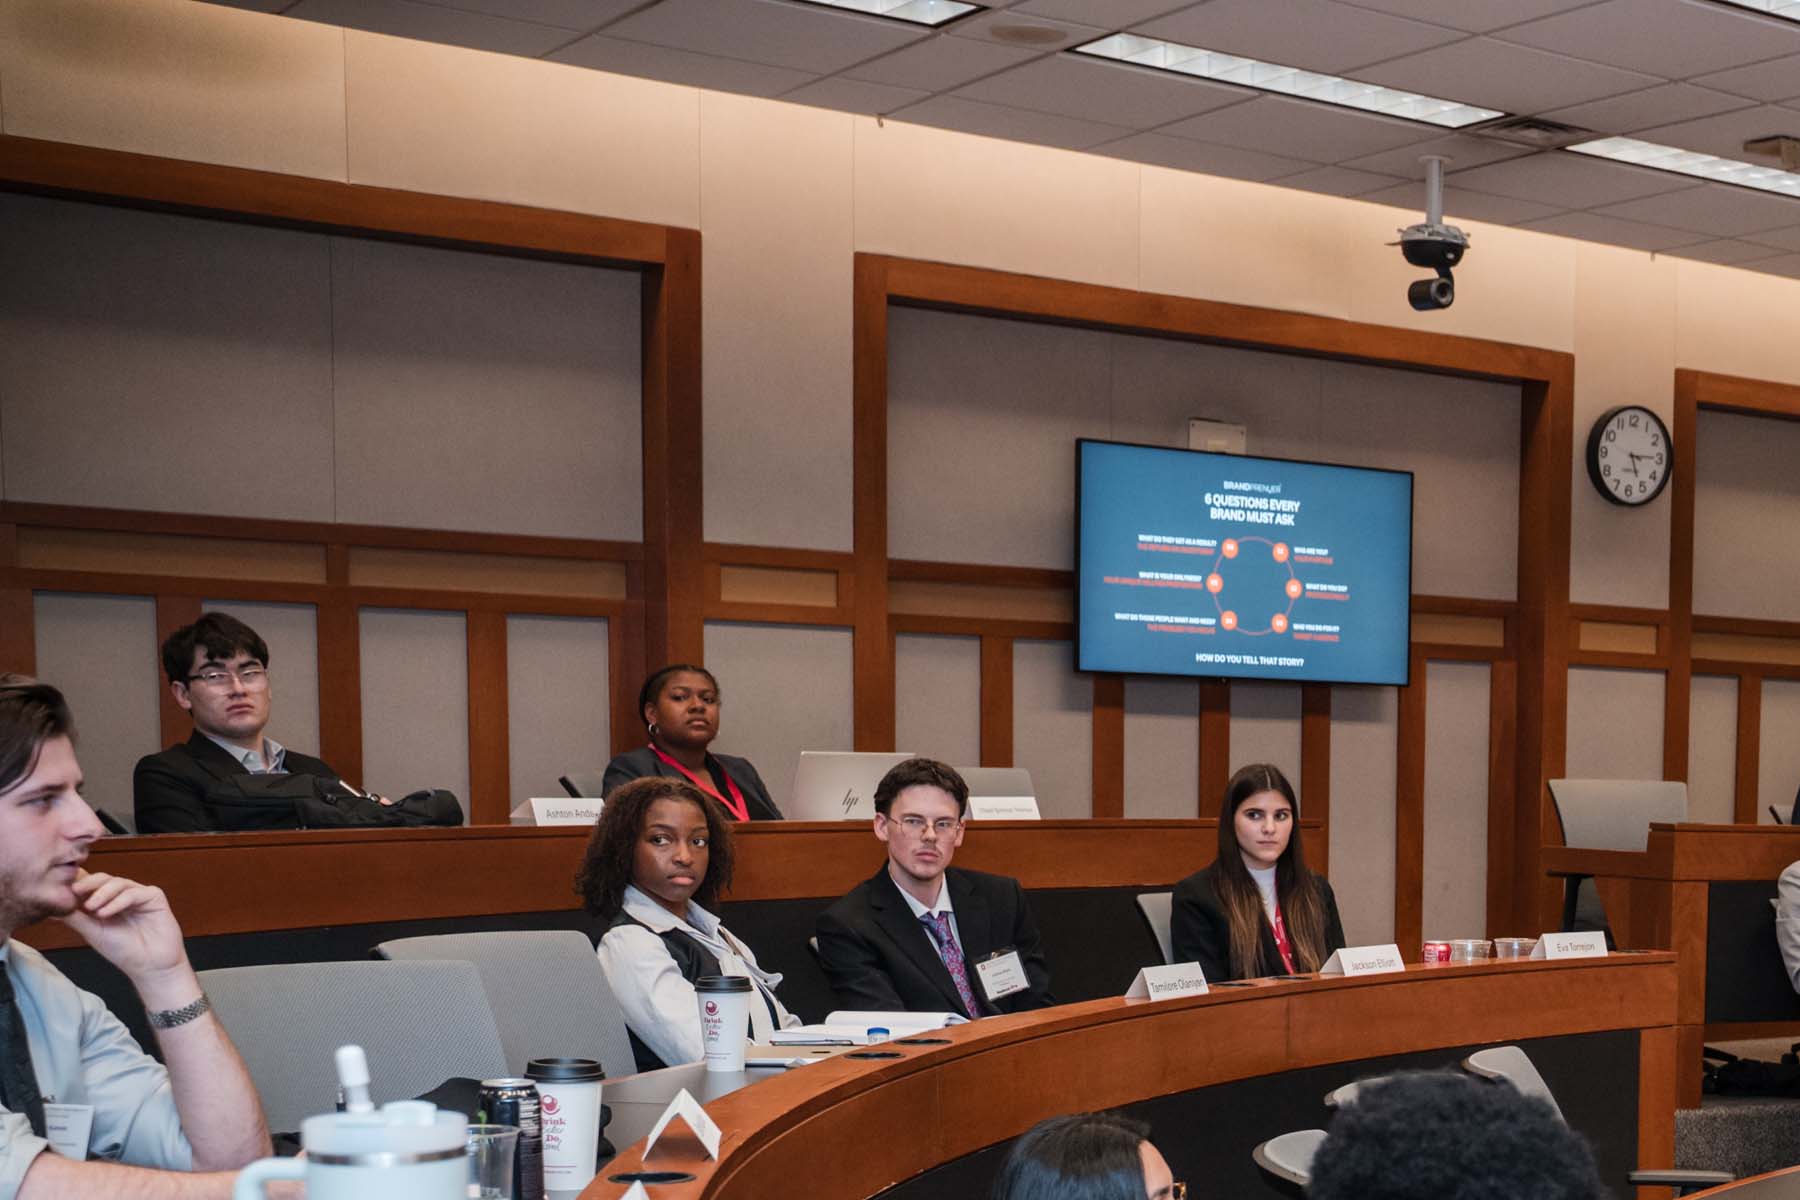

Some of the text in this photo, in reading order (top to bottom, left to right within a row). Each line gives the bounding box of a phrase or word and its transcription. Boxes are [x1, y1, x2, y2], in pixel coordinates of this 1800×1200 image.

[1617, 418, 1624, 430] 11
[1629, 415, 1639, 428] 12
[1605, 429, 1616, 442] 10
[1651, 433, 1659, 447] 2
[1600, 446, 1608, 458] 9
[1655, 452, 1663, 465] 3
[1603, 464, 1611, 477] 8
[1649, 470, 1657, 482] 4
[1613, 479, 1620, 492] 7
[1624, 484, 1632, 497] 6
[1639, 480, 1647, 493] 5
[1204, 493, 1300, 512] 6 QUESTIONS EVERY
[1210, 507, 1295, 526] BRAND MUST ASK
[1196, 653, 1304, 667] HOW DO YOU TELL THAT STORY?
[1556, 943, 1568, 953] Eva
[1352, 961, 1376, 970] Jackson
